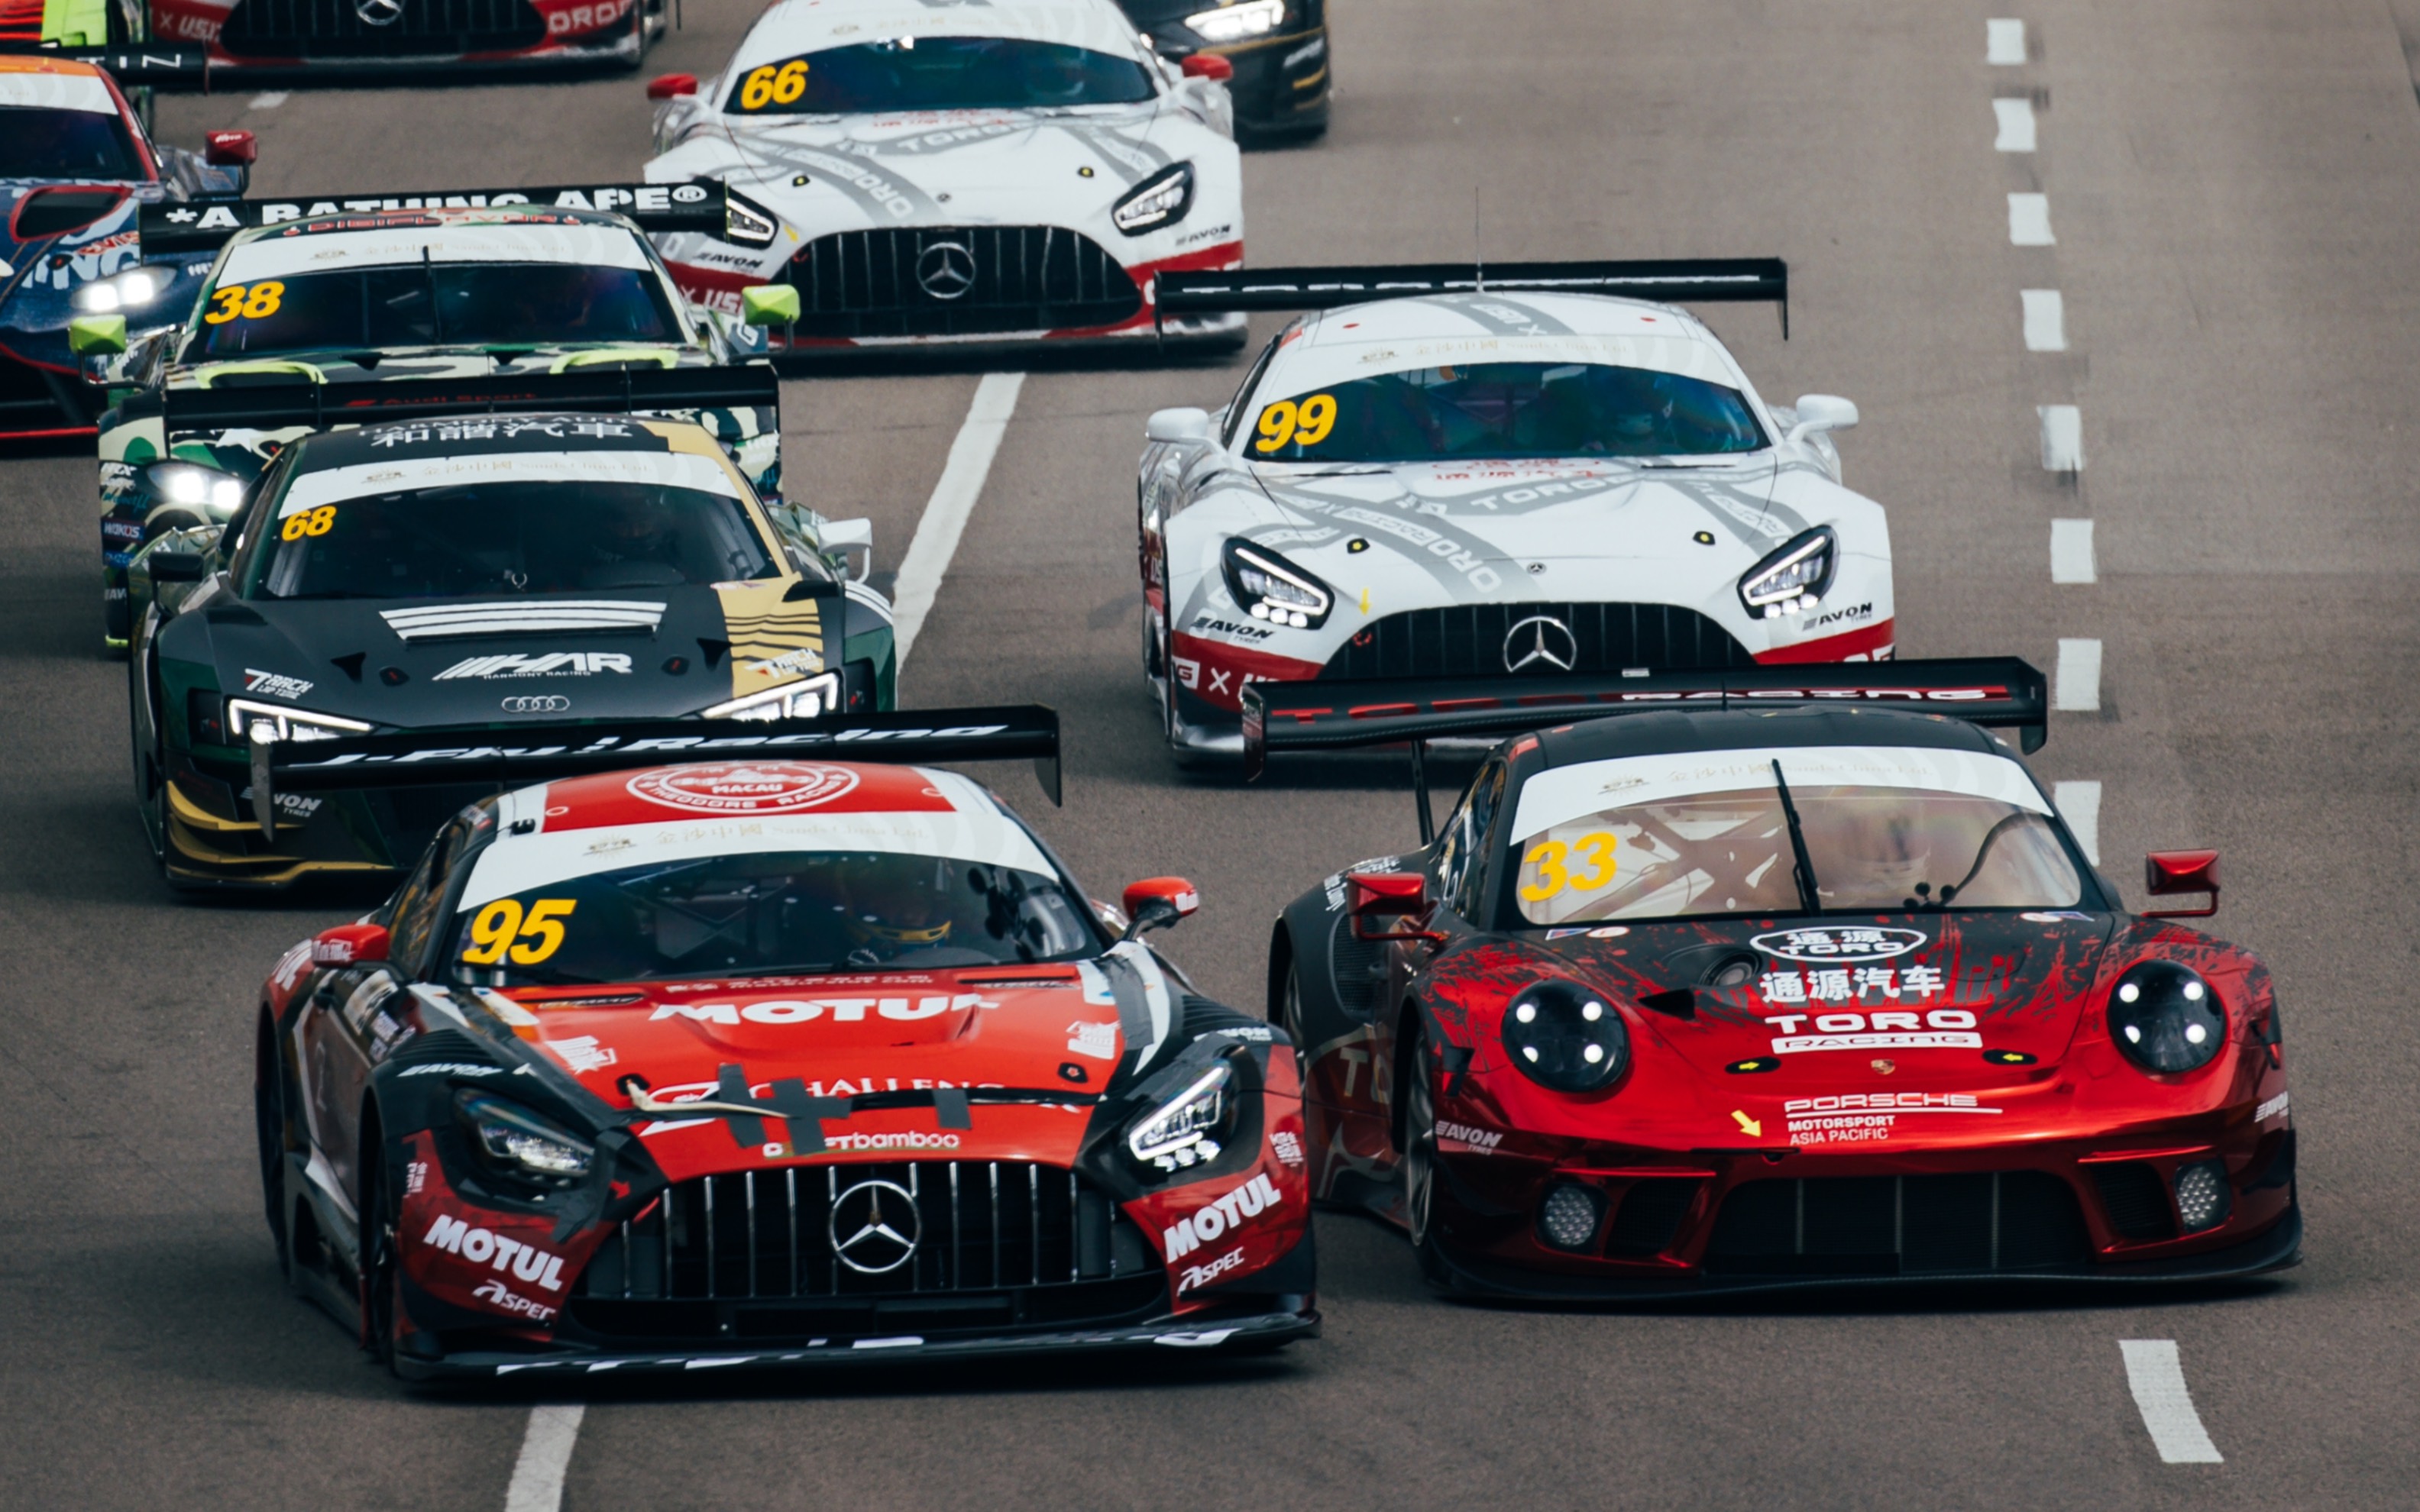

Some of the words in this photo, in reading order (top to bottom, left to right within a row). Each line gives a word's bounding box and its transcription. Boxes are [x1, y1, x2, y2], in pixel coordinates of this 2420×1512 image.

[741, 60, 809, 109] 66
[204, 281, 285, 325] 38
[1256, 393, 1337, 453] 99
[282, 505, 337, 541] 68
[1819, 602, 1872, 626] AVON
[1208, 619, 1276, 639] AVON
[273, 793, 323, 812] VON
[711, 783, 784, 794] MACAU
[1519, 832, 1618, 903] 33
[462, 899, 578, 965] 95
[1779, 941, 1905, 955] TORO
[1758, 964, 1946, 1004] 通源汽车
[648, 993, 1001, 1026] MOTUL
[1765, 1009, 1978, 1035] TORO
[1784, 1032, 1971, 1049] RACING
[1784, 1093, 1979, 1113] PORSCHE
[1445, 1123, 1503, 1148] AVON
[1787, 1115, 1896, 1132] MOTORSPORT
[1790, 1130, 1826, 1146] ASIA
[1828, 1127, 1889, 1142] PACIFIC
[1163, 1172, 1283, 1265] MOTUL
[422, 1213, 565, 1292] MOTUL
[1176, 1245, 1245, 1297] ASPEC
